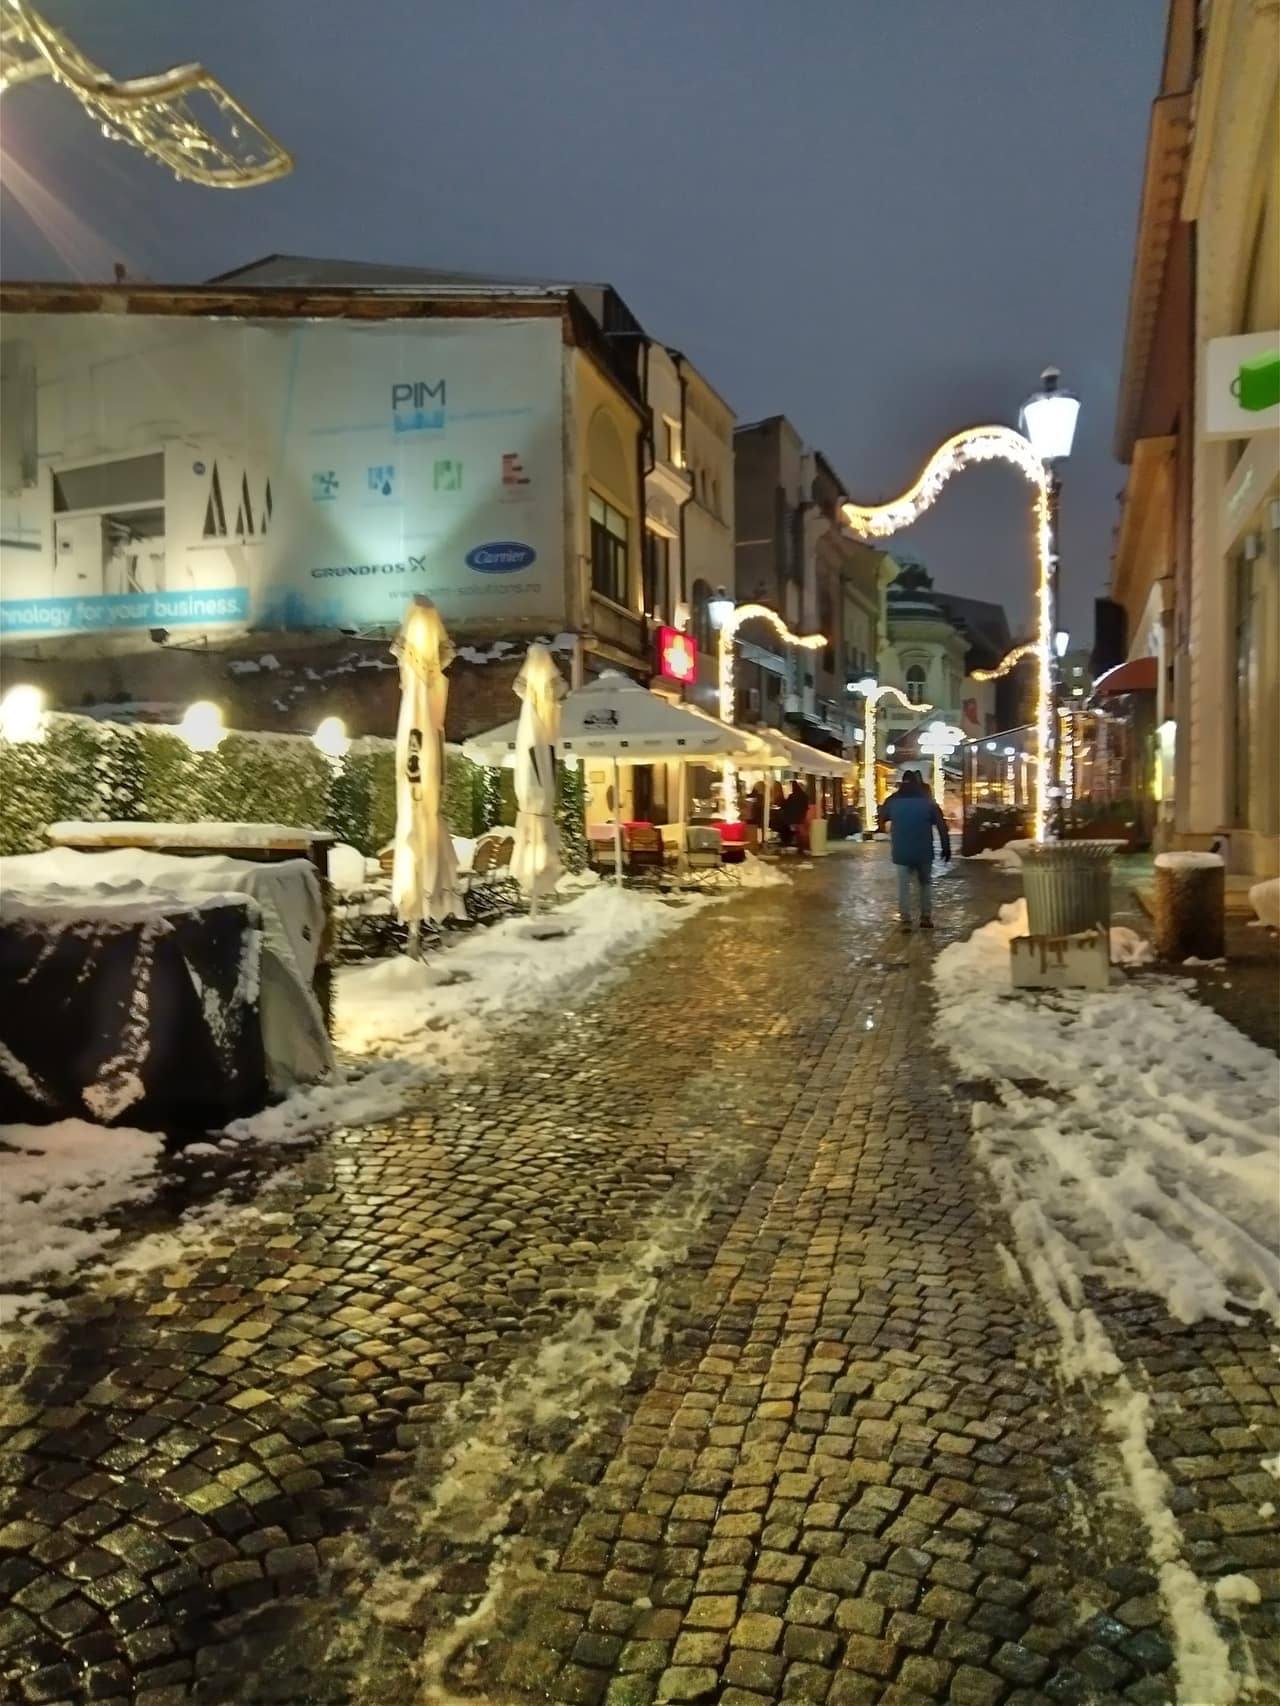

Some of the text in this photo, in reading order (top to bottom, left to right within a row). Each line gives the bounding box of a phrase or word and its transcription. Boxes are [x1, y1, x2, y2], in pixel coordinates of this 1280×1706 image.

[392, 379, 446, 410] PIM
[310, 563, 406, 579] GRUNDFOS
[107, 601, 149, 625] your
[154, 595, 241, 619] business.
